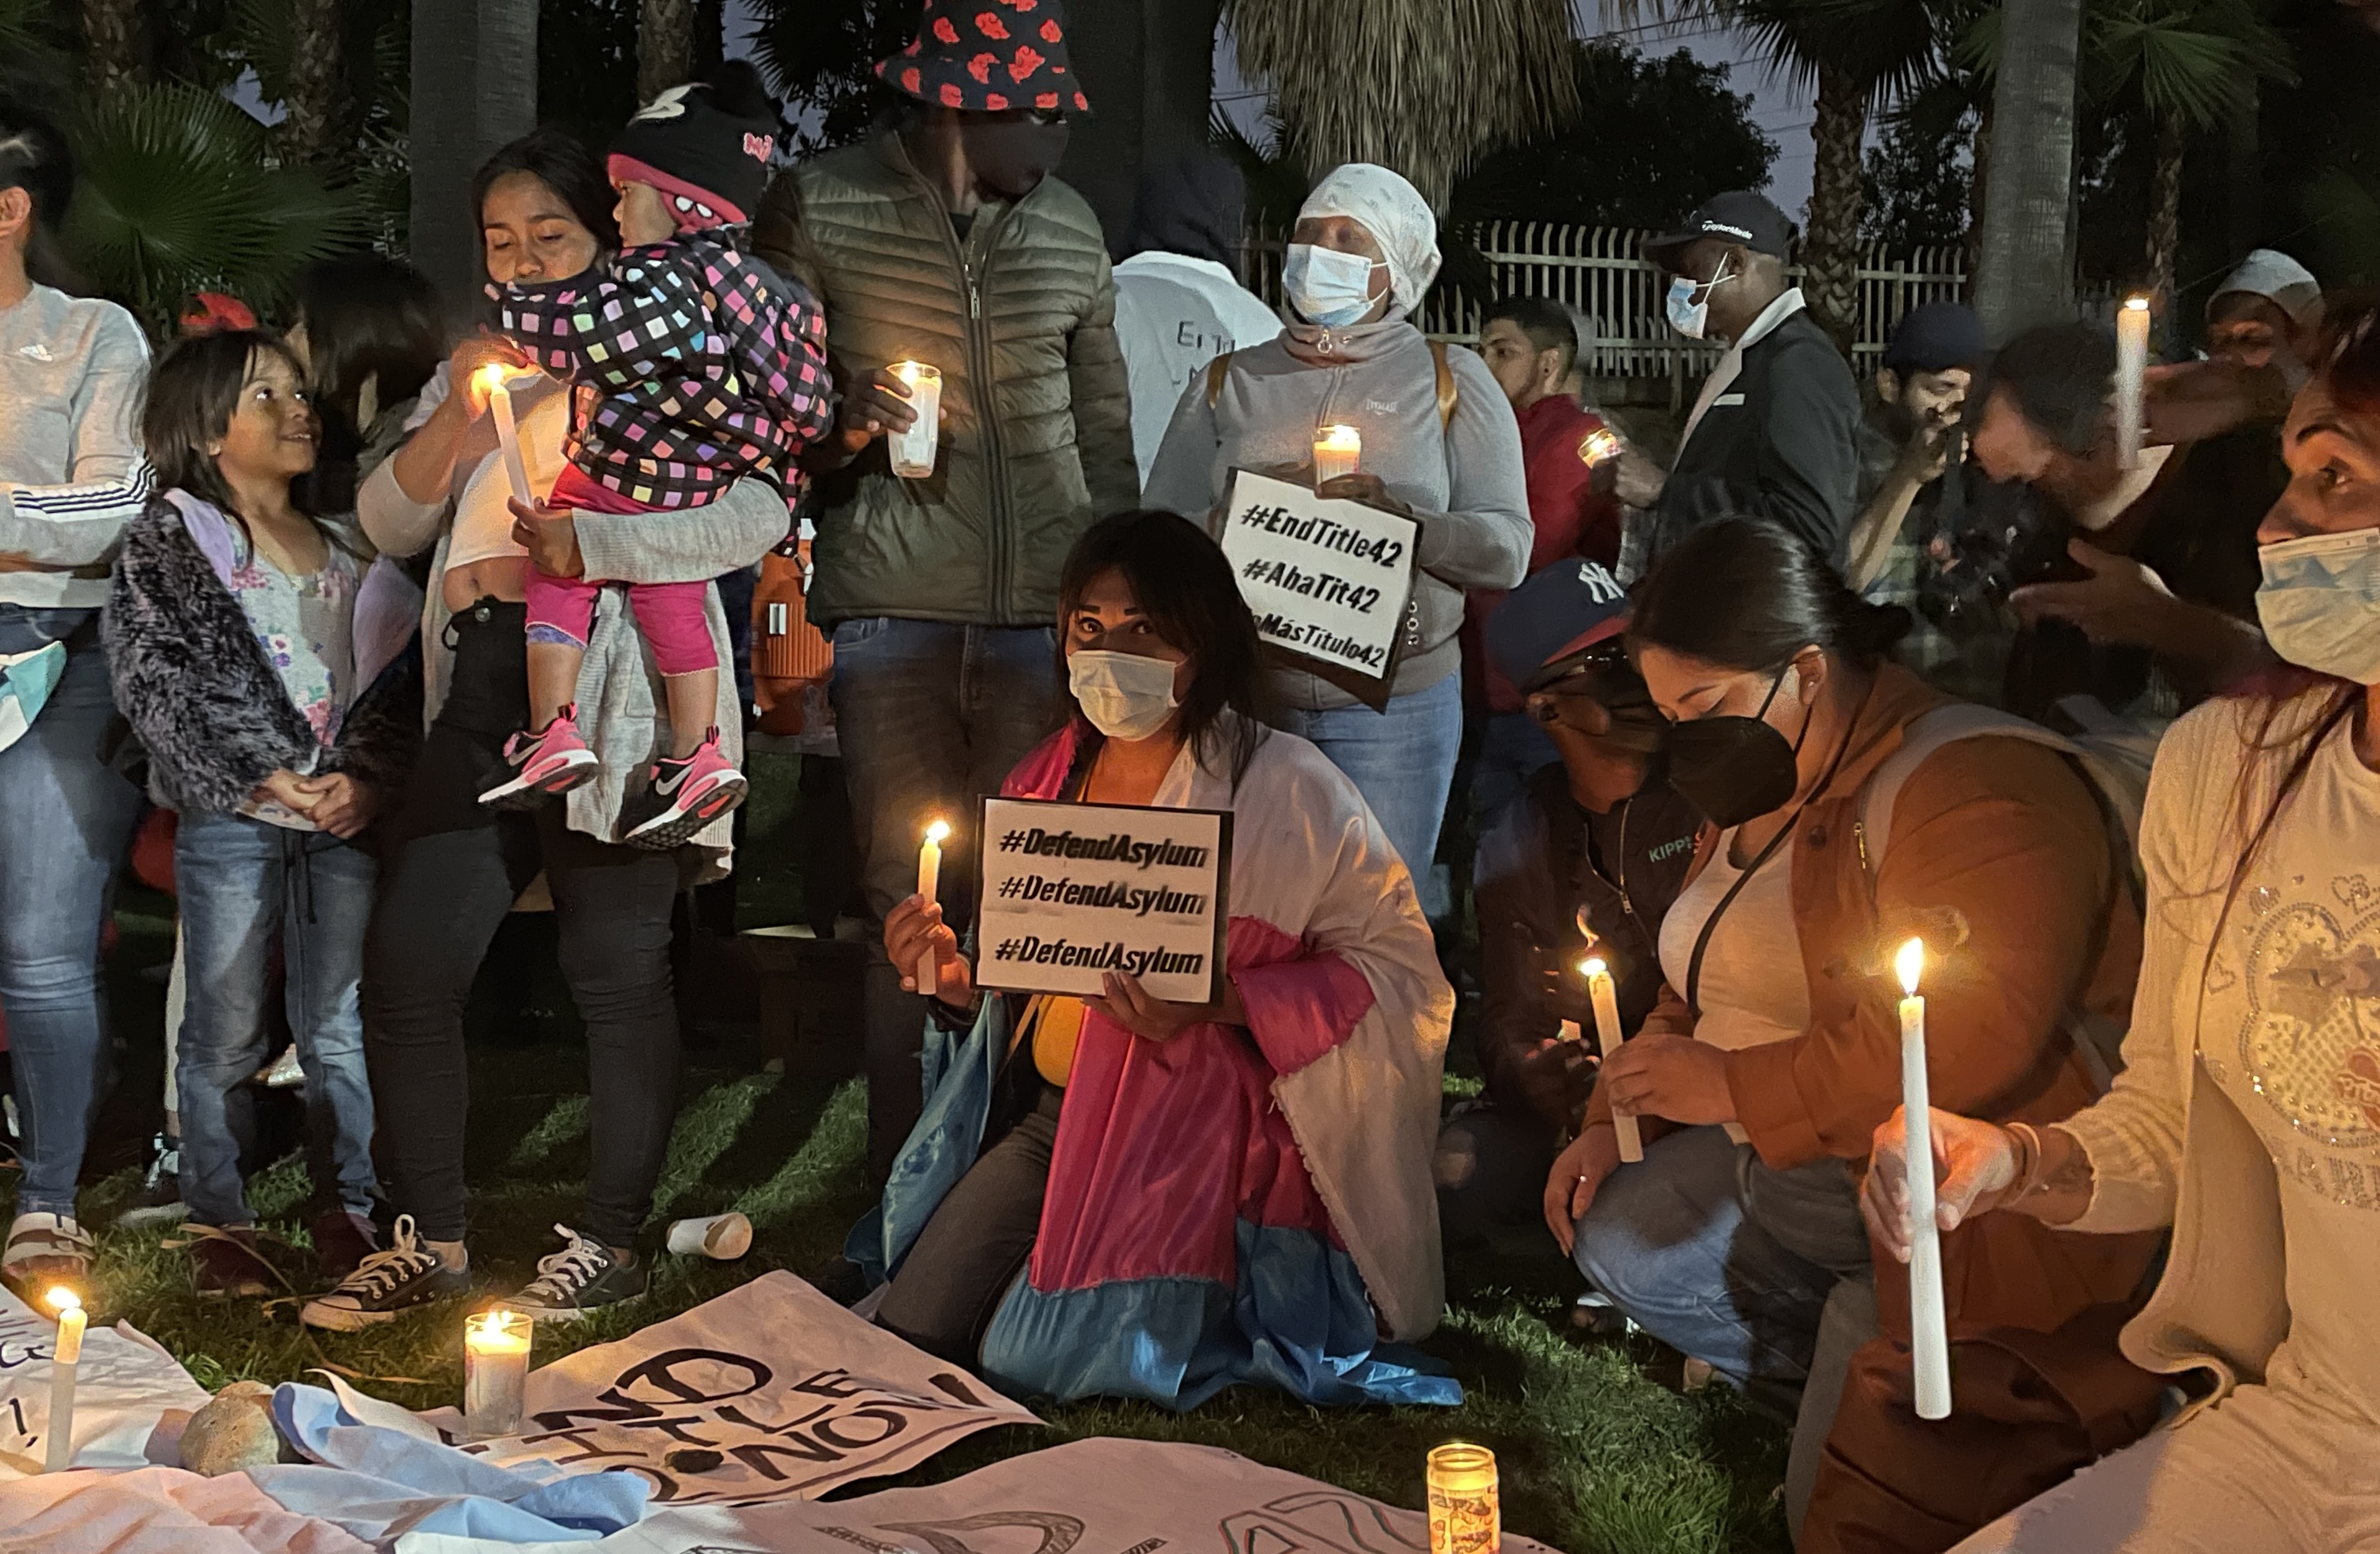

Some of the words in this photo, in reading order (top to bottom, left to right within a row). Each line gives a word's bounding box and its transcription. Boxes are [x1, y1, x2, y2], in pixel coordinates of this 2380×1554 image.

[1240, 505, 1403, 567] #EndTitle42
[1578, 562, 1624, 604] NY
[999, 828, 1211, 870] #DefendAsylum
[998, 874, 1208, 917] #DefendAsylum
[995, 936, 1204, 977] #DefendAsylum
